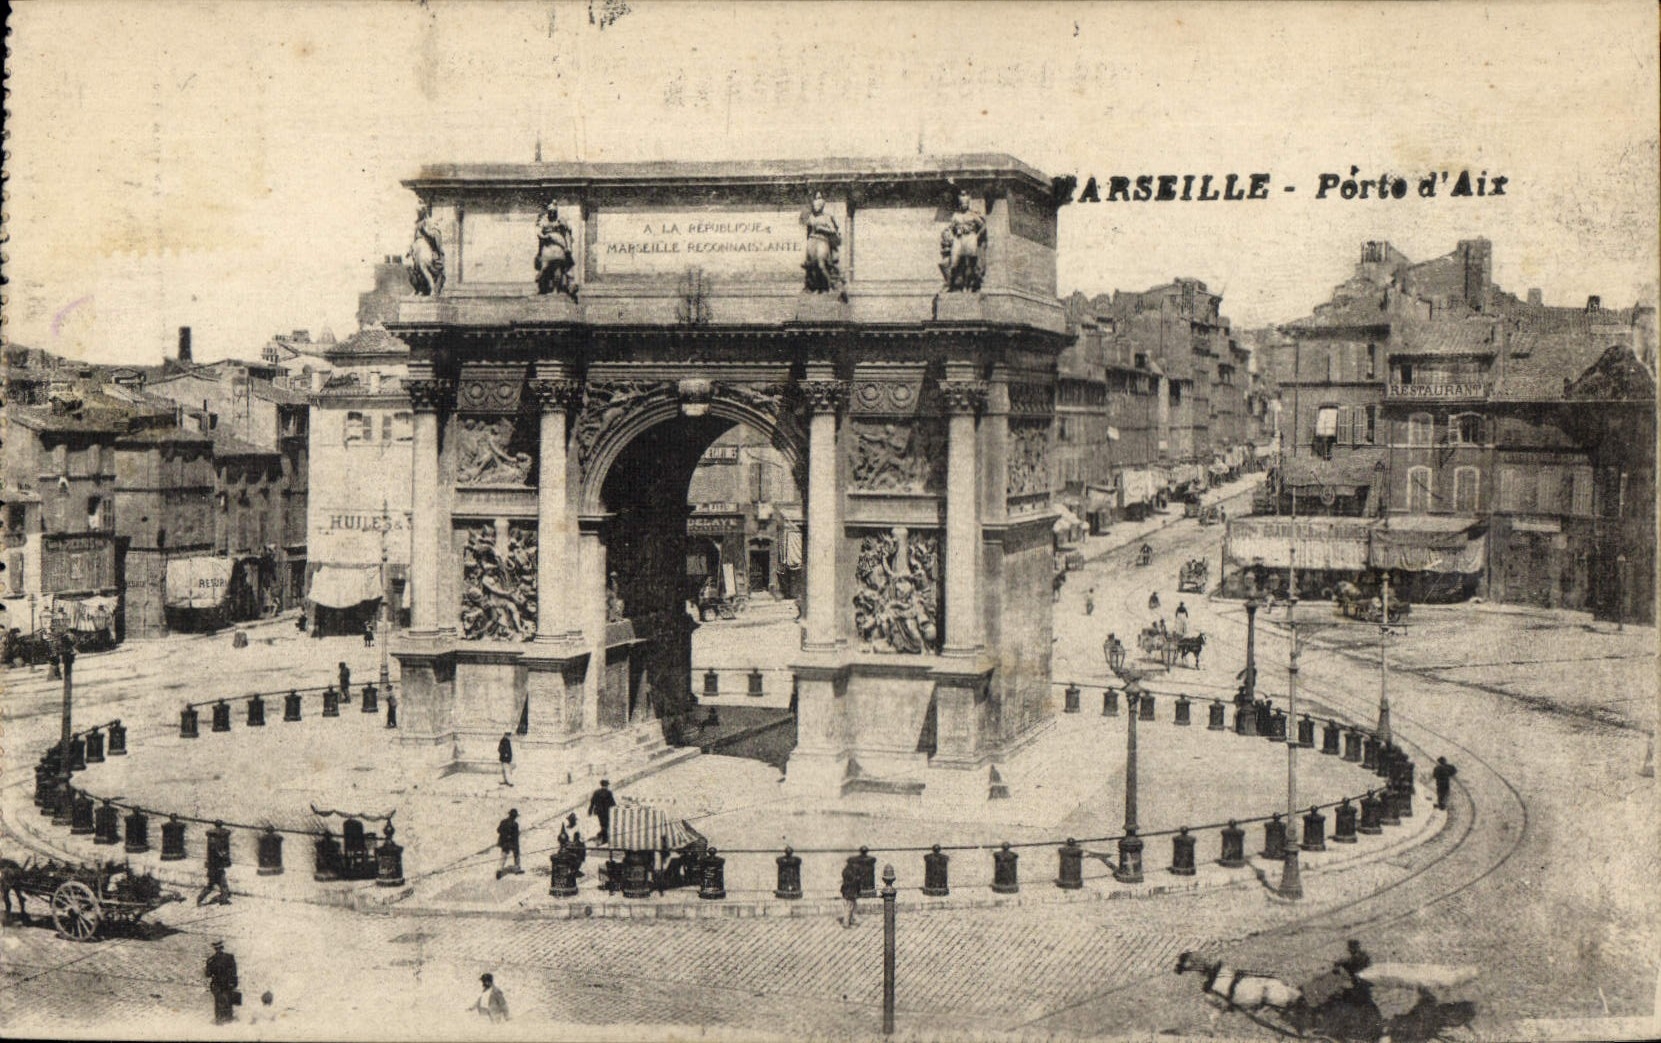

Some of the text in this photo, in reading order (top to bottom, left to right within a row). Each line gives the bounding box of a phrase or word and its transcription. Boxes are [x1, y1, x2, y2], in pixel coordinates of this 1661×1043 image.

[662, 223, 681, 235] LA
[607, 242, 681, 255] MARSEILLE
[1389, 383, 1482, 397] RESTAURANT
[328, 514, 392, 533] HUILES
